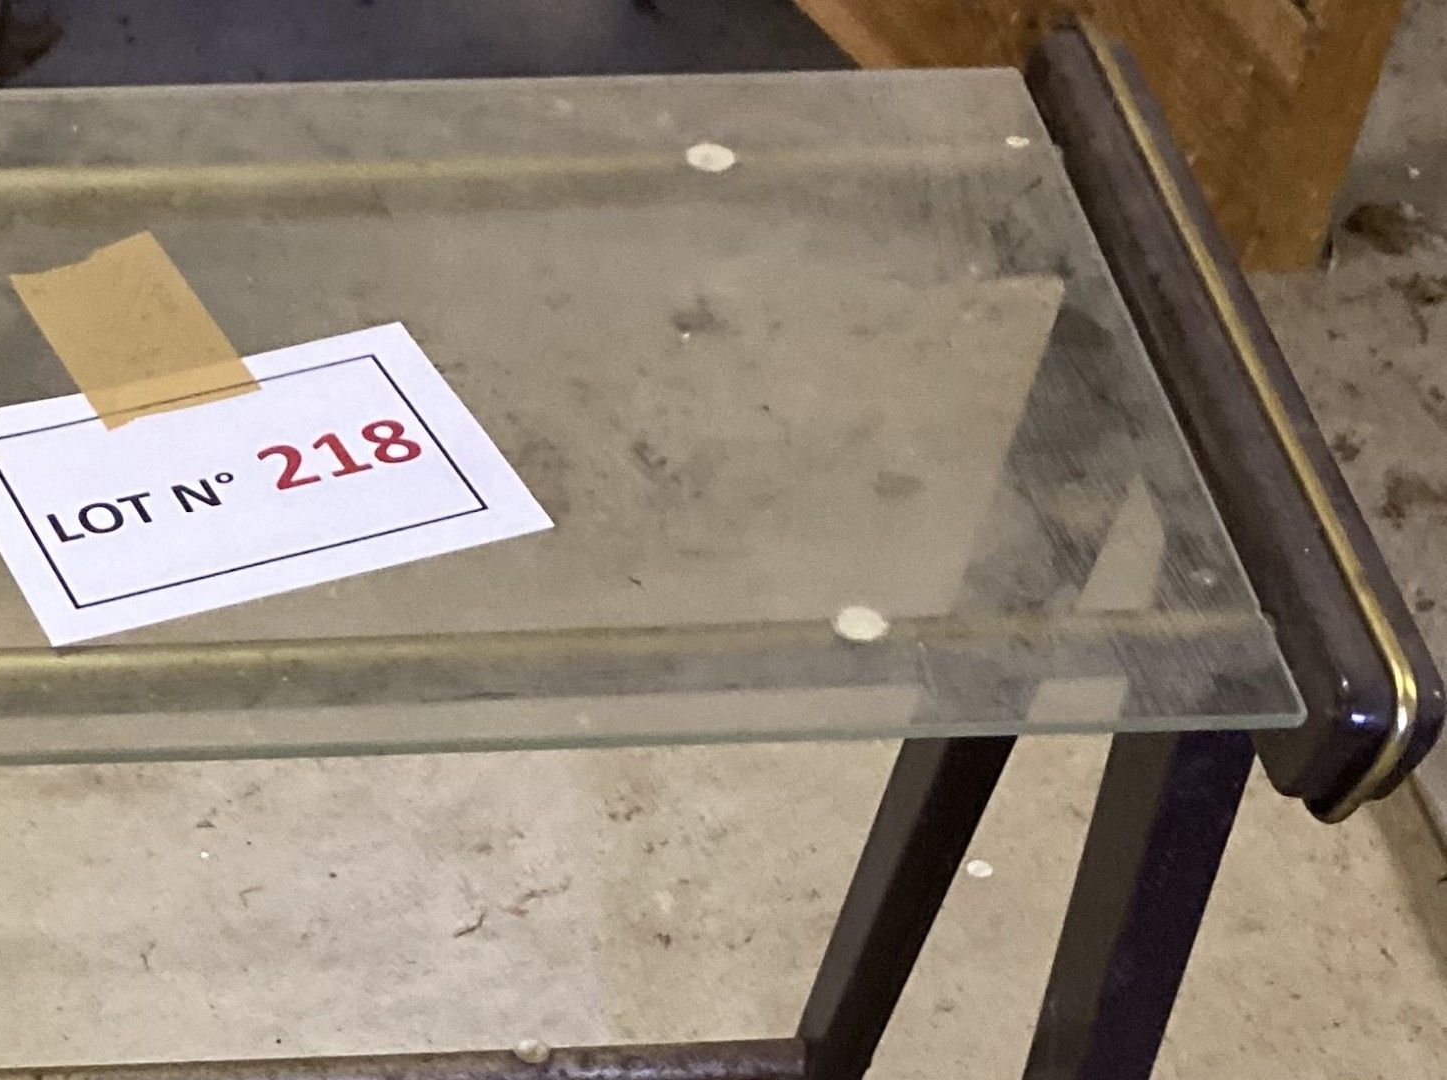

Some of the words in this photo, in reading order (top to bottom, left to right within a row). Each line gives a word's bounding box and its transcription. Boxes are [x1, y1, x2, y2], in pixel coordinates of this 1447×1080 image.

[47, 492, 153, 543] LOT
[171, 472, 235, 513] N°
[257, 420, 422, 490] 218
